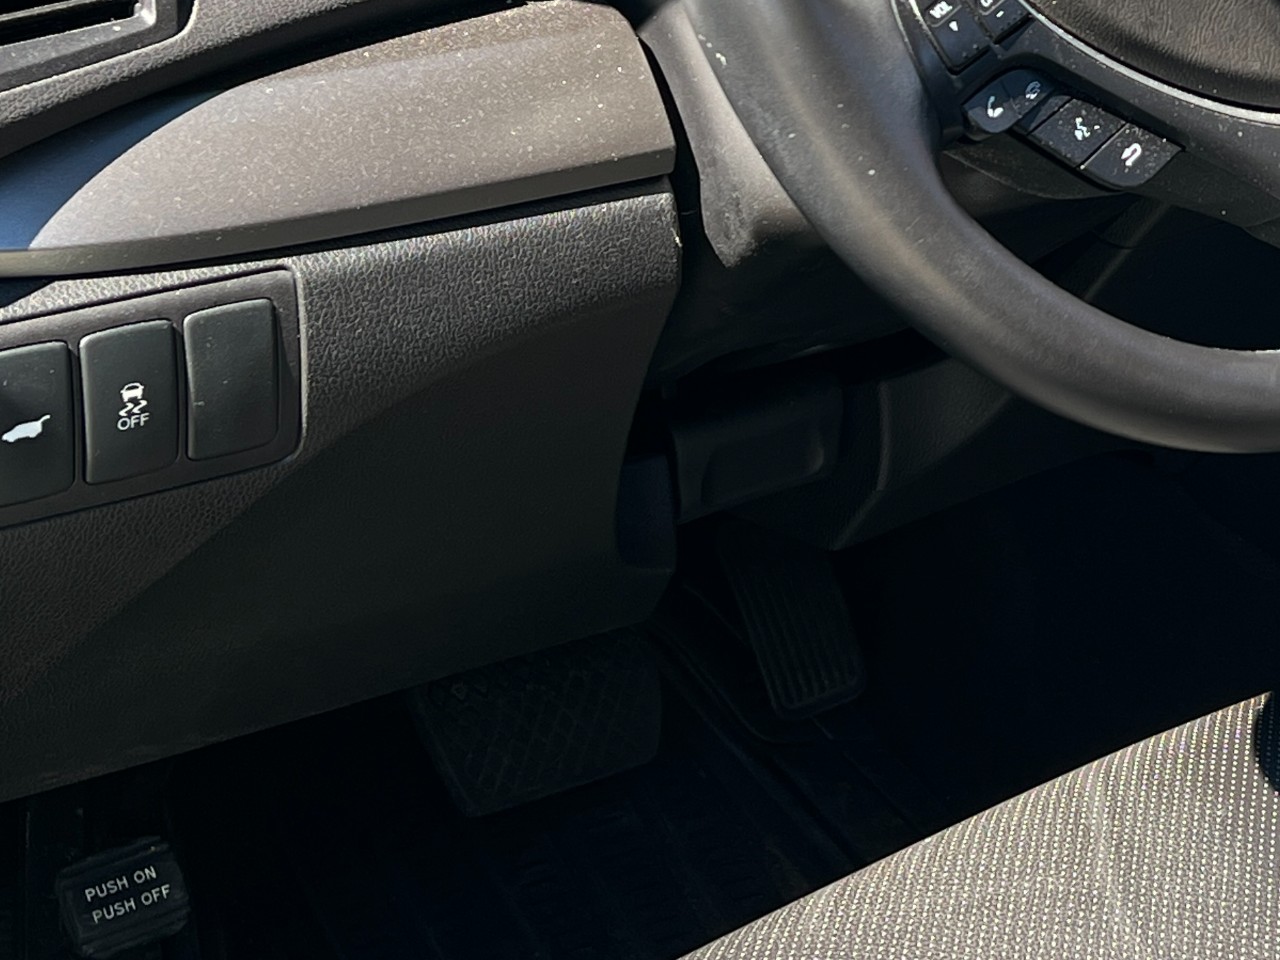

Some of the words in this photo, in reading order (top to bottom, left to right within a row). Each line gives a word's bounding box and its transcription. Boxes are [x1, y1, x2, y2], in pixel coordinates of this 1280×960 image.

[930, 0, 953, 19] VOL
[117, 412, 150, 431] OFF
[84, 875, 129, 903] PUSH
[133, 865, 157, 884] ON
[91, 897, 137, 924] PUSH
[140, 883, 171, 906] OFF
